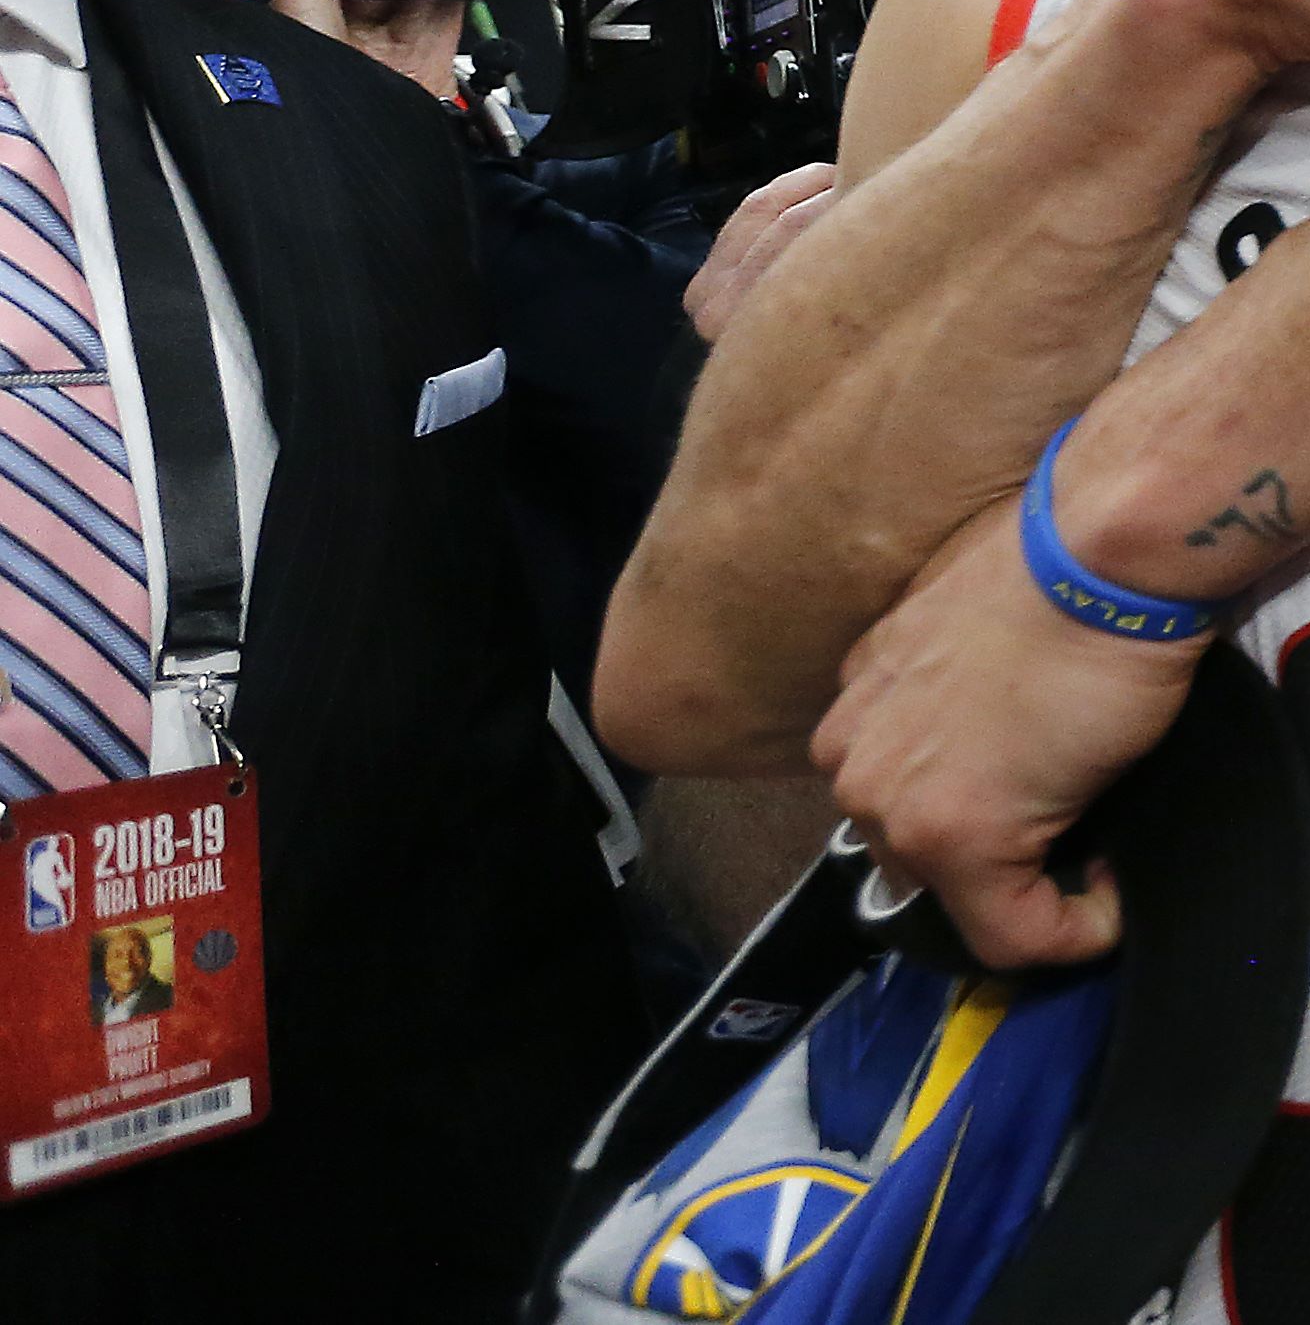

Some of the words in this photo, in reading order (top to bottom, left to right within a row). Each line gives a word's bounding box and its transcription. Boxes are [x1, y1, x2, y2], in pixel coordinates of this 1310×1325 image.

[93, 802, 226, 879] 2018-19
[94, 875, 140, 919] NBA
[143, 858, 226, 906] OFFICIAL
